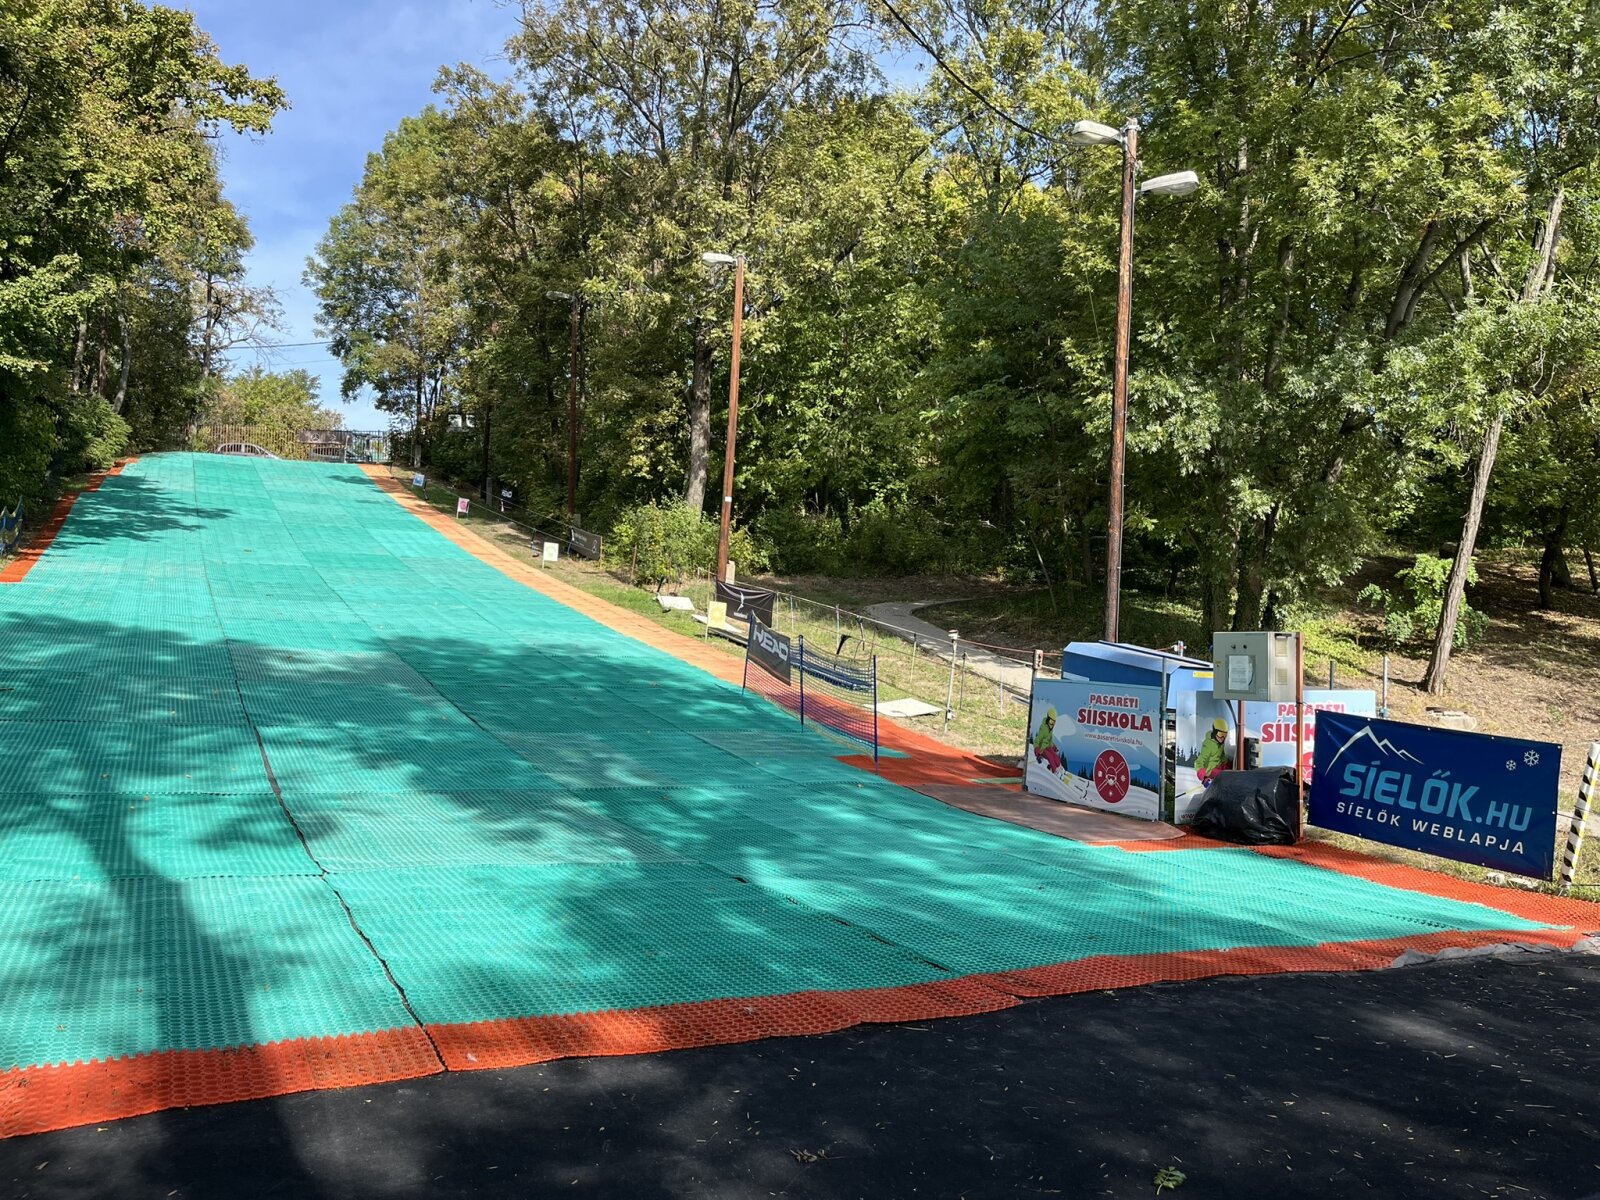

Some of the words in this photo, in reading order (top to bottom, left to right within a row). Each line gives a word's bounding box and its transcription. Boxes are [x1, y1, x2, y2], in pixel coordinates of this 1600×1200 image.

[753, 625, 789, 662] HEAD
[1089, 693, 1139, 709] PASARÉTI
[1278, 701, 1345, 716] PAARÉTI
[1077, 705, 1153, 732] SÍISKOLA
[1339, 760, 1533, 832] SÍELŐK.HU
[1336, 801, 1401, 827] SÍELŐK
[1412, 818, 1525, 855] WEBLAPJA
